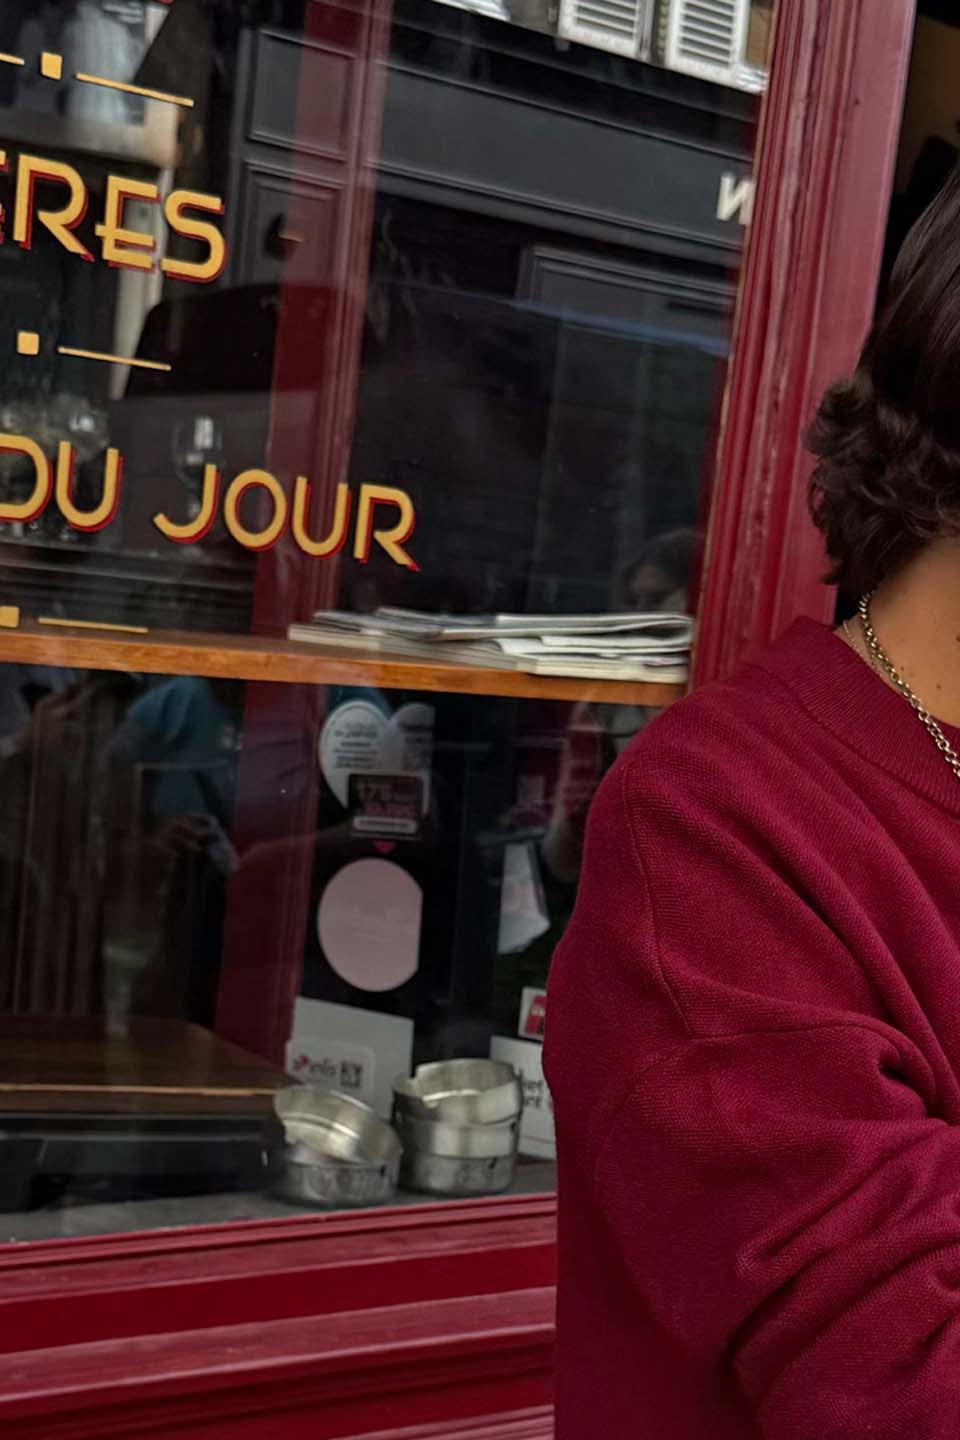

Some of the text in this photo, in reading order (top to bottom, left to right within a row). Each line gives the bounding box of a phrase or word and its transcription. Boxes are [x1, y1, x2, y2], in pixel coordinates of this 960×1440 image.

[0, 150, 231, 283] RES
[0, 432, 420, 573] DU JOUR
